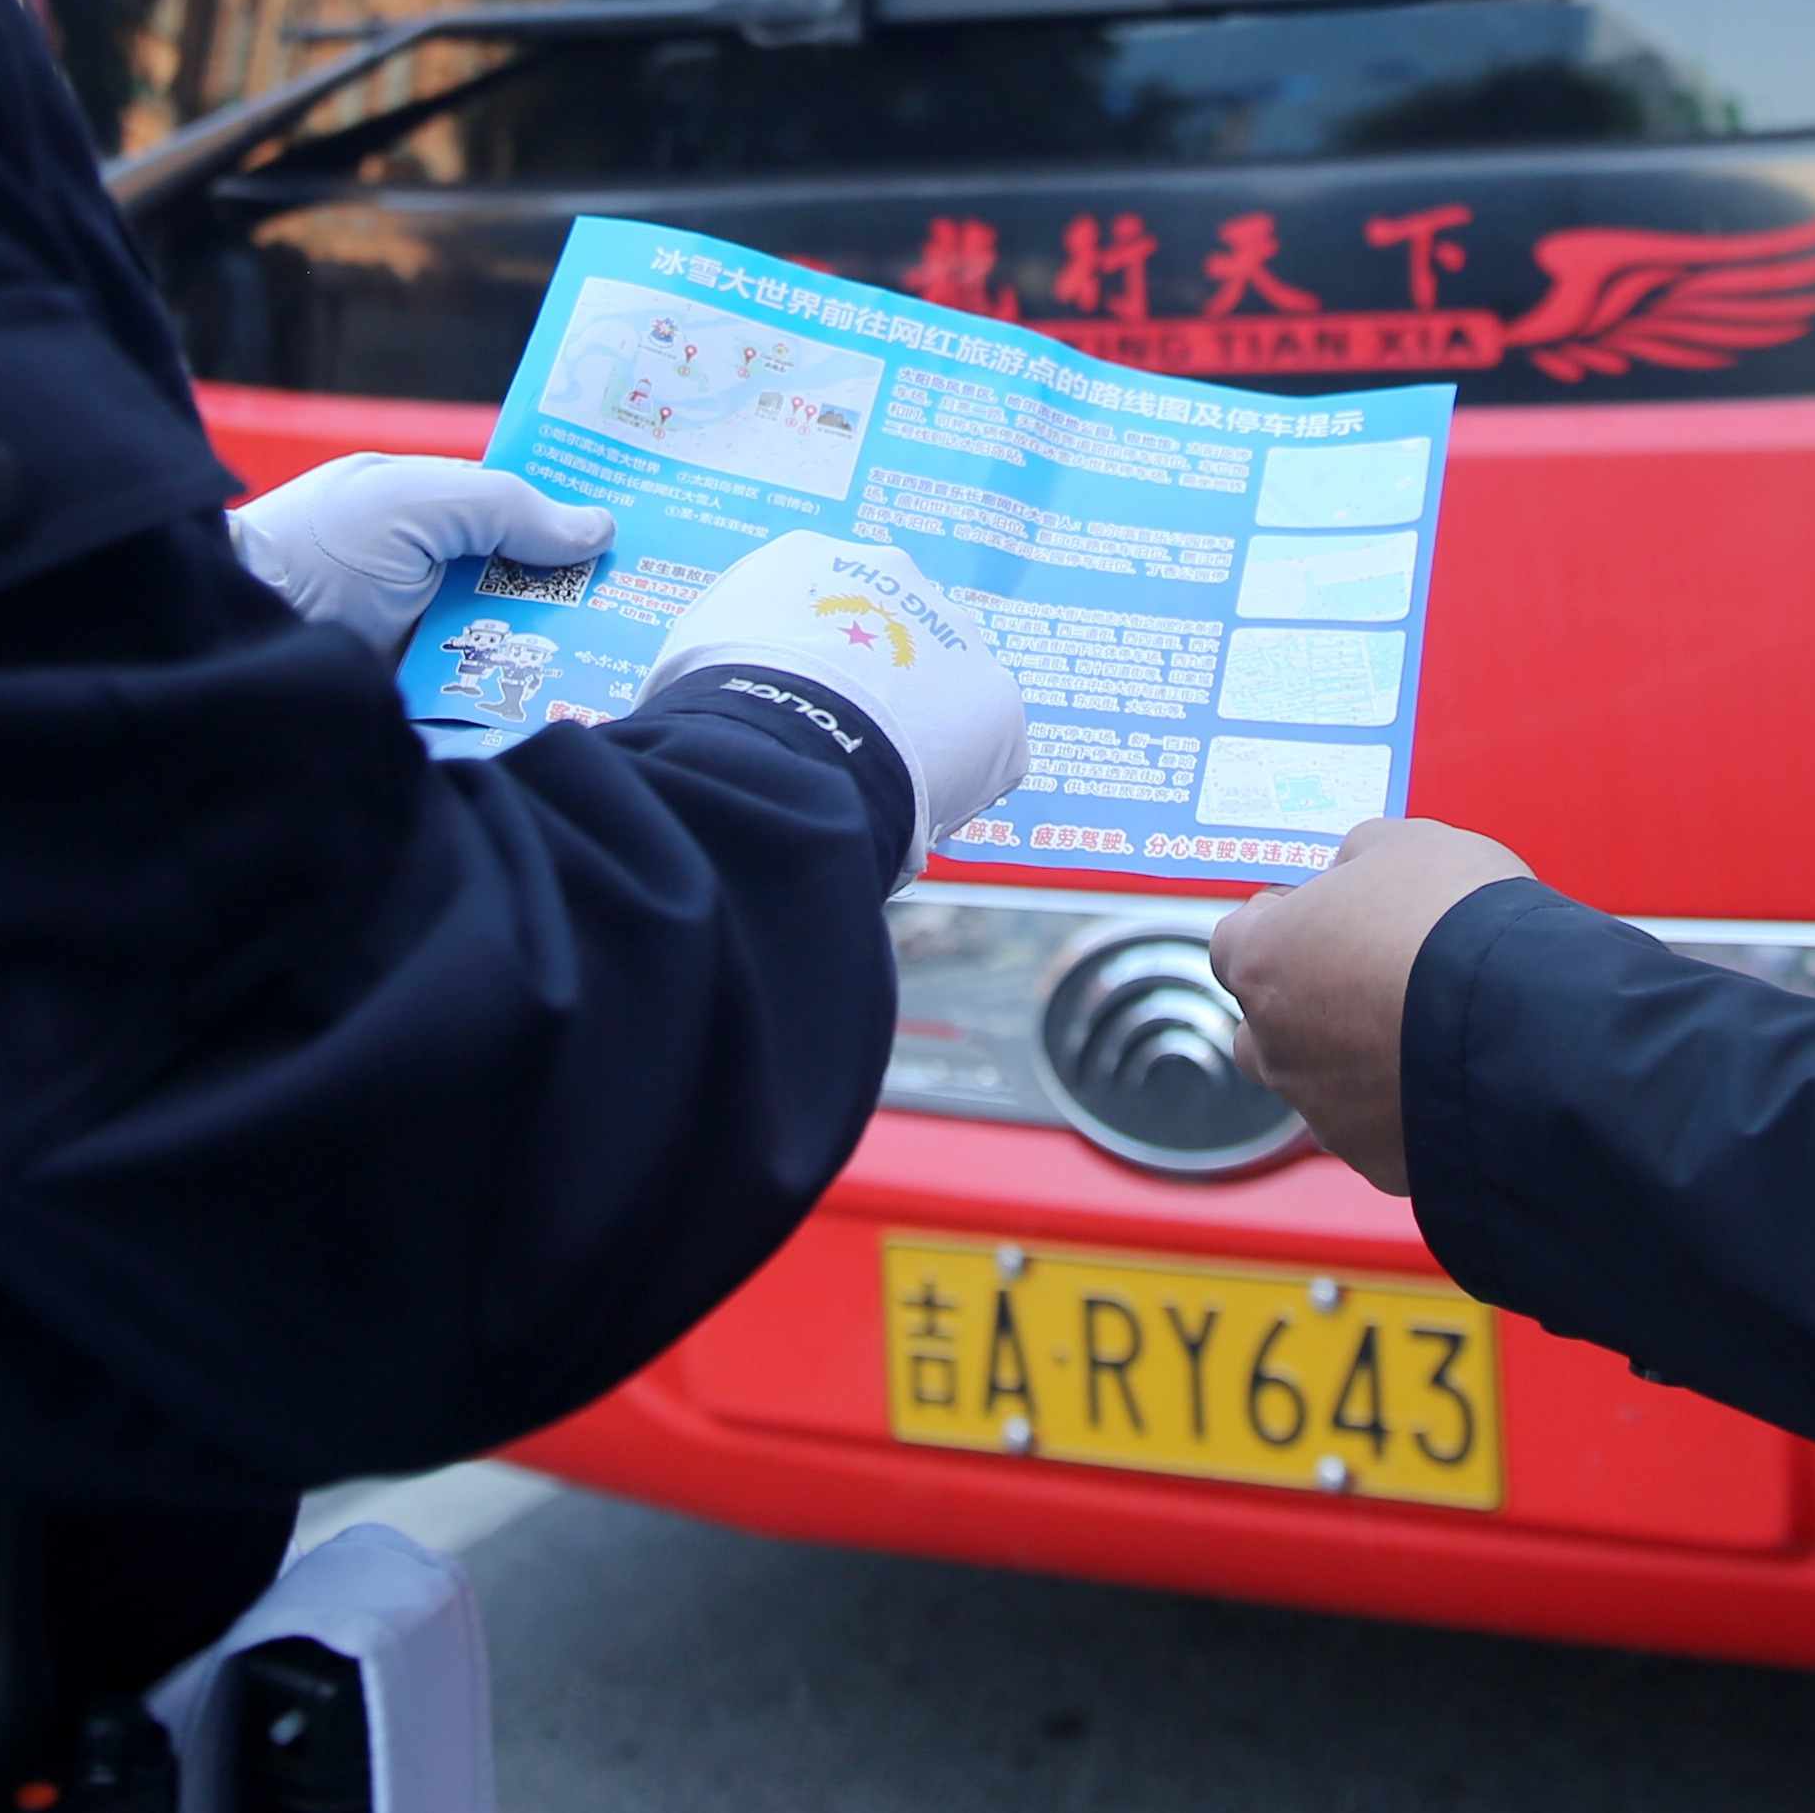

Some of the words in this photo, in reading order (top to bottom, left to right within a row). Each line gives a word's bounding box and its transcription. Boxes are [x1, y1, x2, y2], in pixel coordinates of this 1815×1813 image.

[649, 246, 1365, 439] 冰雪大世界前往网红旅游点的路线图及停车提示
[1218, 326, 1350, 363] TIAN
[1382, 324, 1478, 361] XIA
[831, 556, 901, 597] CHA
[900, 592, 968, 652] JING
[719, 676, 864, 754] POLICE
[950, 818, 1339, 872] 醉驾、疲劳驾驶、分心驾驶等违法行
